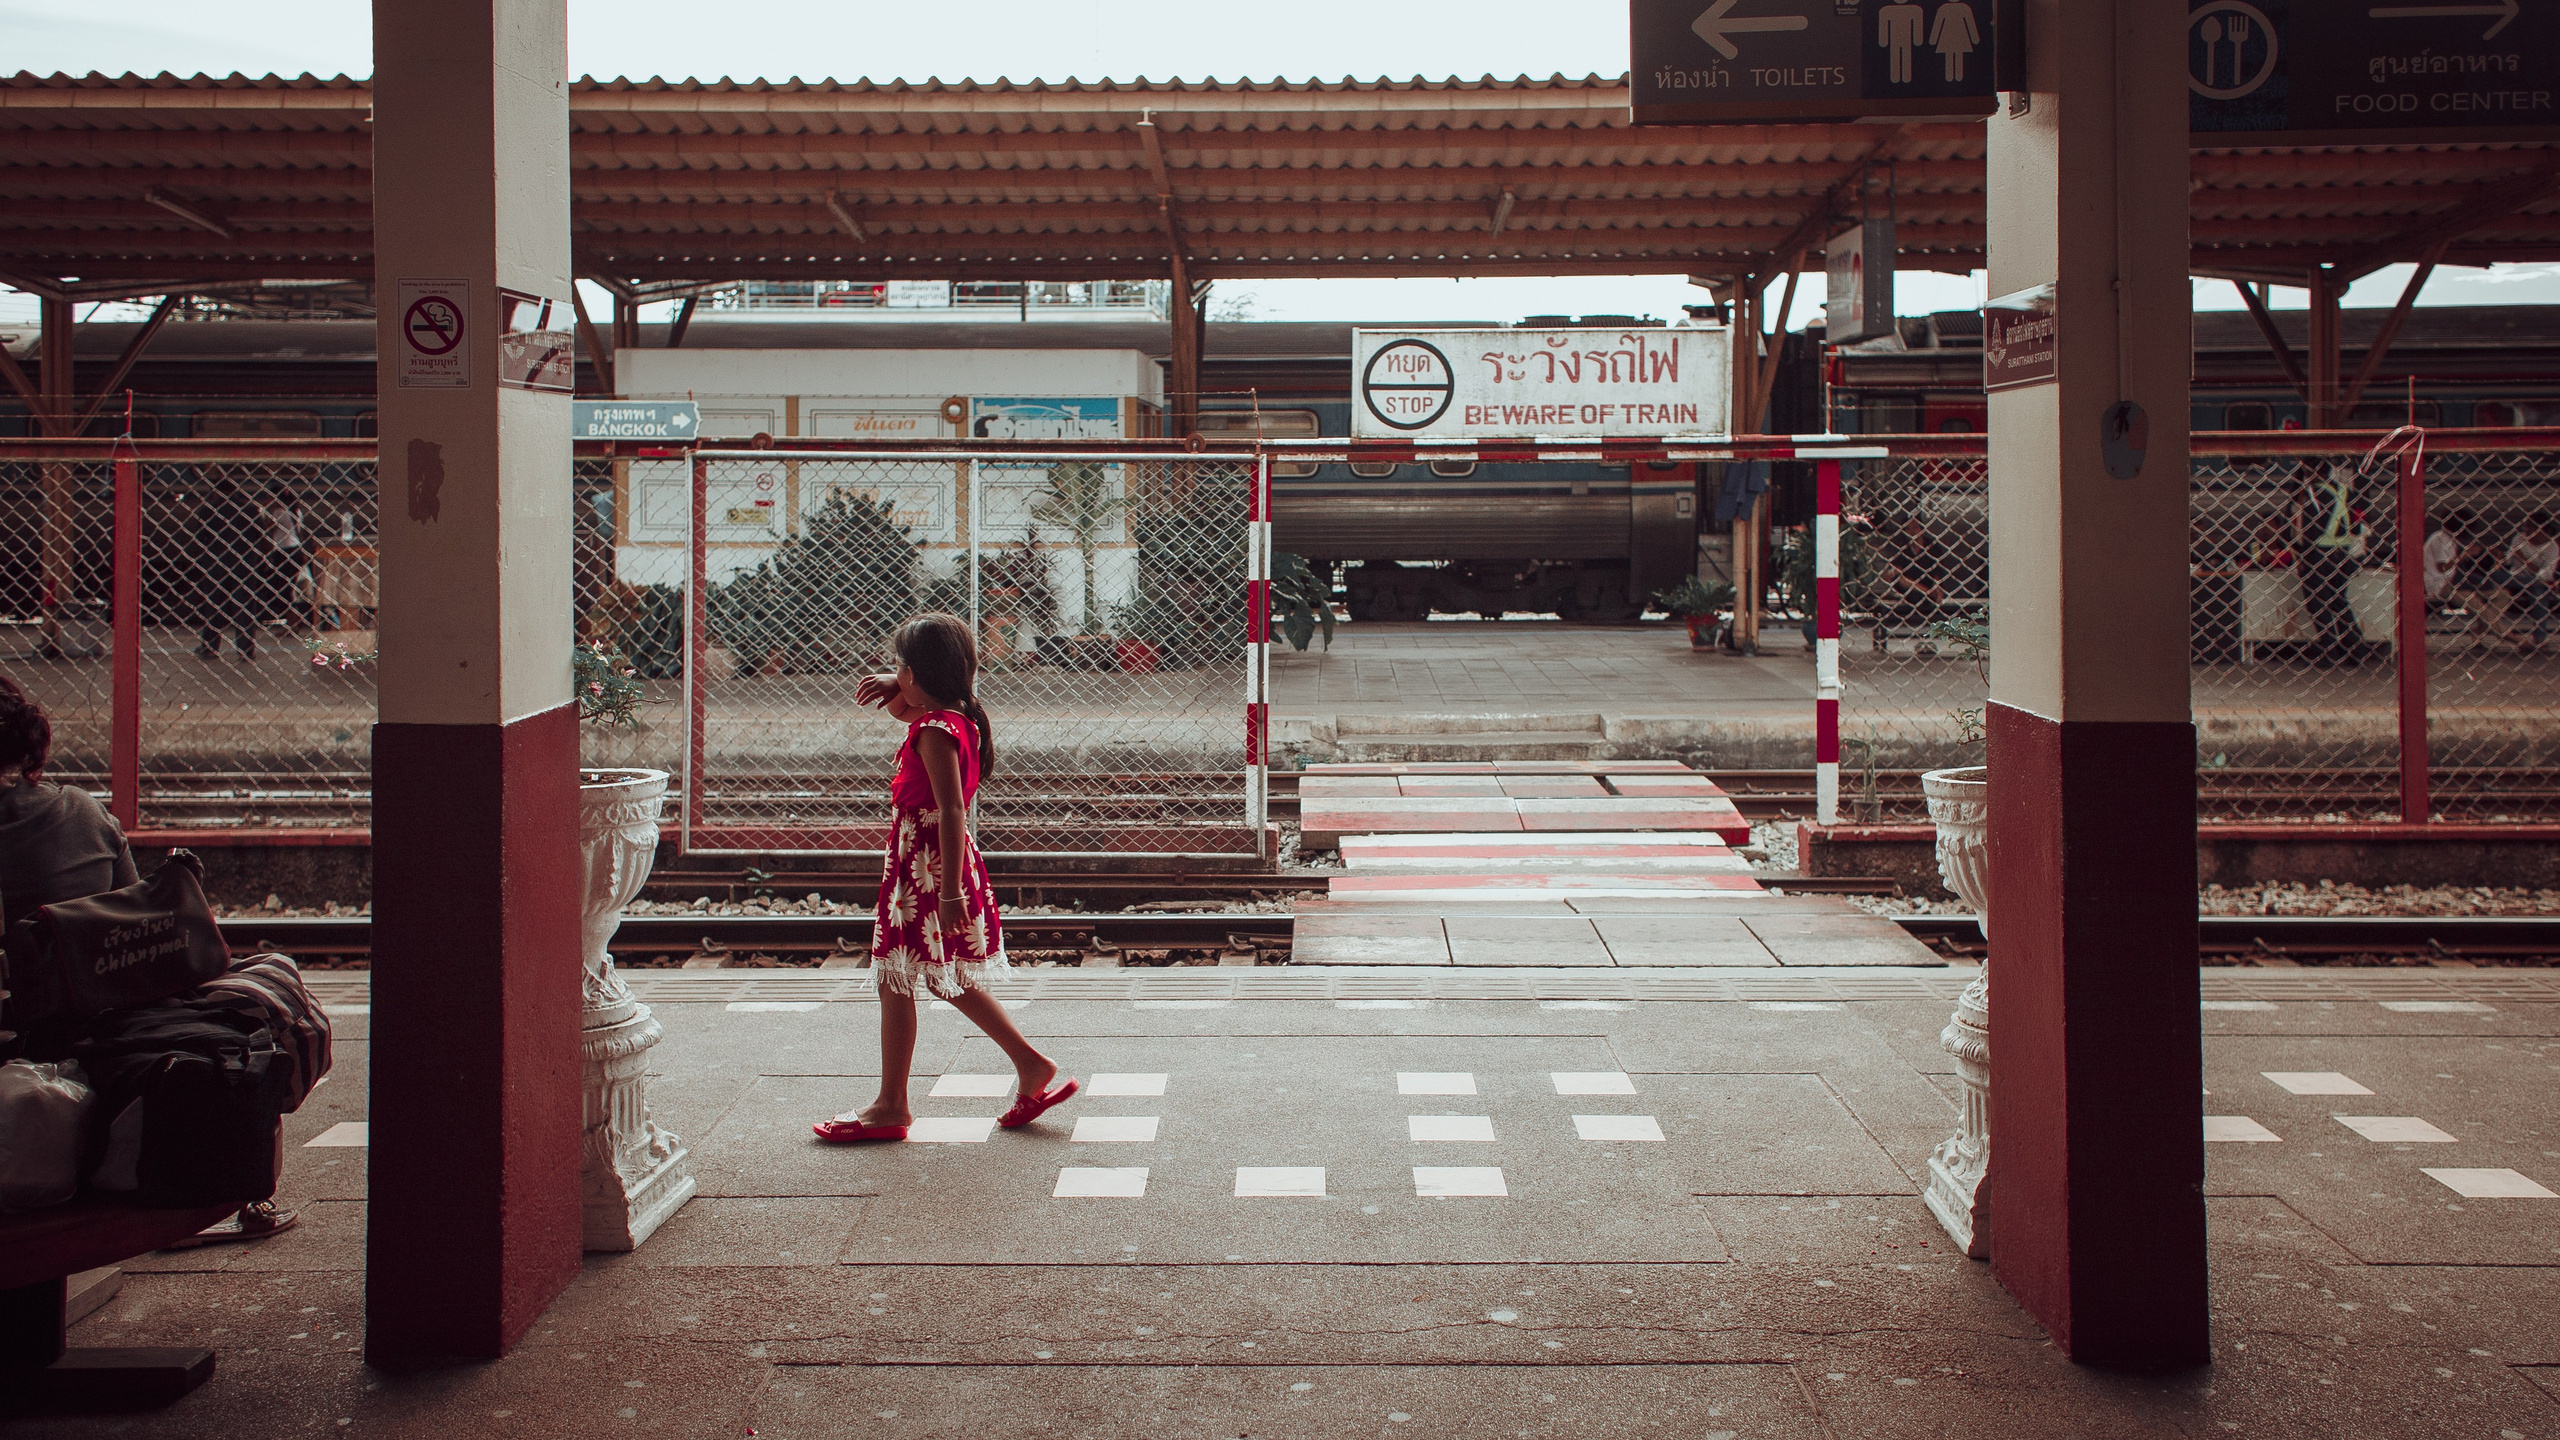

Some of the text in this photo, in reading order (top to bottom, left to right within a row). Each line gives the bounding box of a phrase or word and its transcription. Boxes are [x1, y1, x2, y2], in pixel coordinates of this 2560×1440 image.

[1654, 57, 1731, 89] ห้องน้ำ
[1749, 66, 1845, 87] TOILETS
[2368, 47, 2521, 84] ศูนย์อาหาร
[2335, 91, 2552, 114] FOOD CENTER
[410, 352, 459, 369] ห้ามสูบบุหรี่
[1386, 353, 1431, 382] หยุด
[1480, 333, 1679, 384] ระวังรถไฟ
[2034, 351, 2053, 363] STATION
[1385, 396, 1434, 414] STOP
[1464, 403, 1698, 425] BEWARE OF TRAIN
[593, 408, 656, 425] กรุงเทพฯ
[588, 423, 668, 436] BANGKOK
[94, 929, 190, 975] Chiangmai
